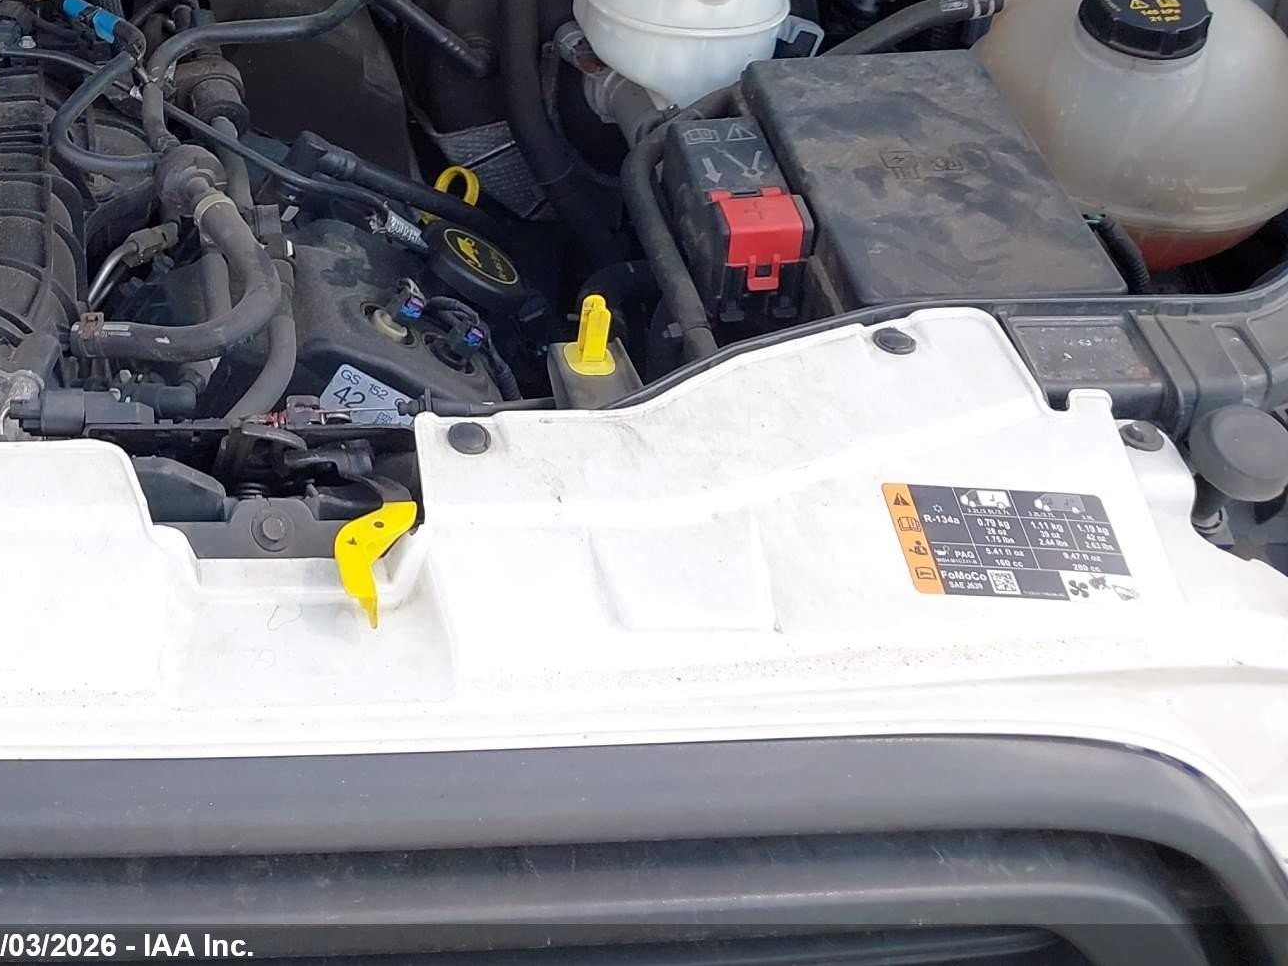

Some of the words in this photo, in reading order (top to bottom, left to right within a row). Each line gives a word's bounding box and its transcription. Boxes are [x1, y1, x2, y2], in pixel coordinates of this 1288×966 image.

[340, 370, 362, 384] GS
[368, 384, 389, 400] 152
[333, 386, 366, 408] 42
[923, 514, 960, 525] R-134a
[977, 518, 996, 527] 0.79
[997, 519, 1010, 529] kg
[1031, 521, 1049, 530] 1.11
[1051, 522, 1064, 532] kg
[1077, 524, 1096, 533] 1.19
[1097, 526, 1109, 536] kg
[955, 550, 975, 559] PAG
[986, 547, 1003, 555] 5.41
[941, 570, 987, 581] FoMoCo
